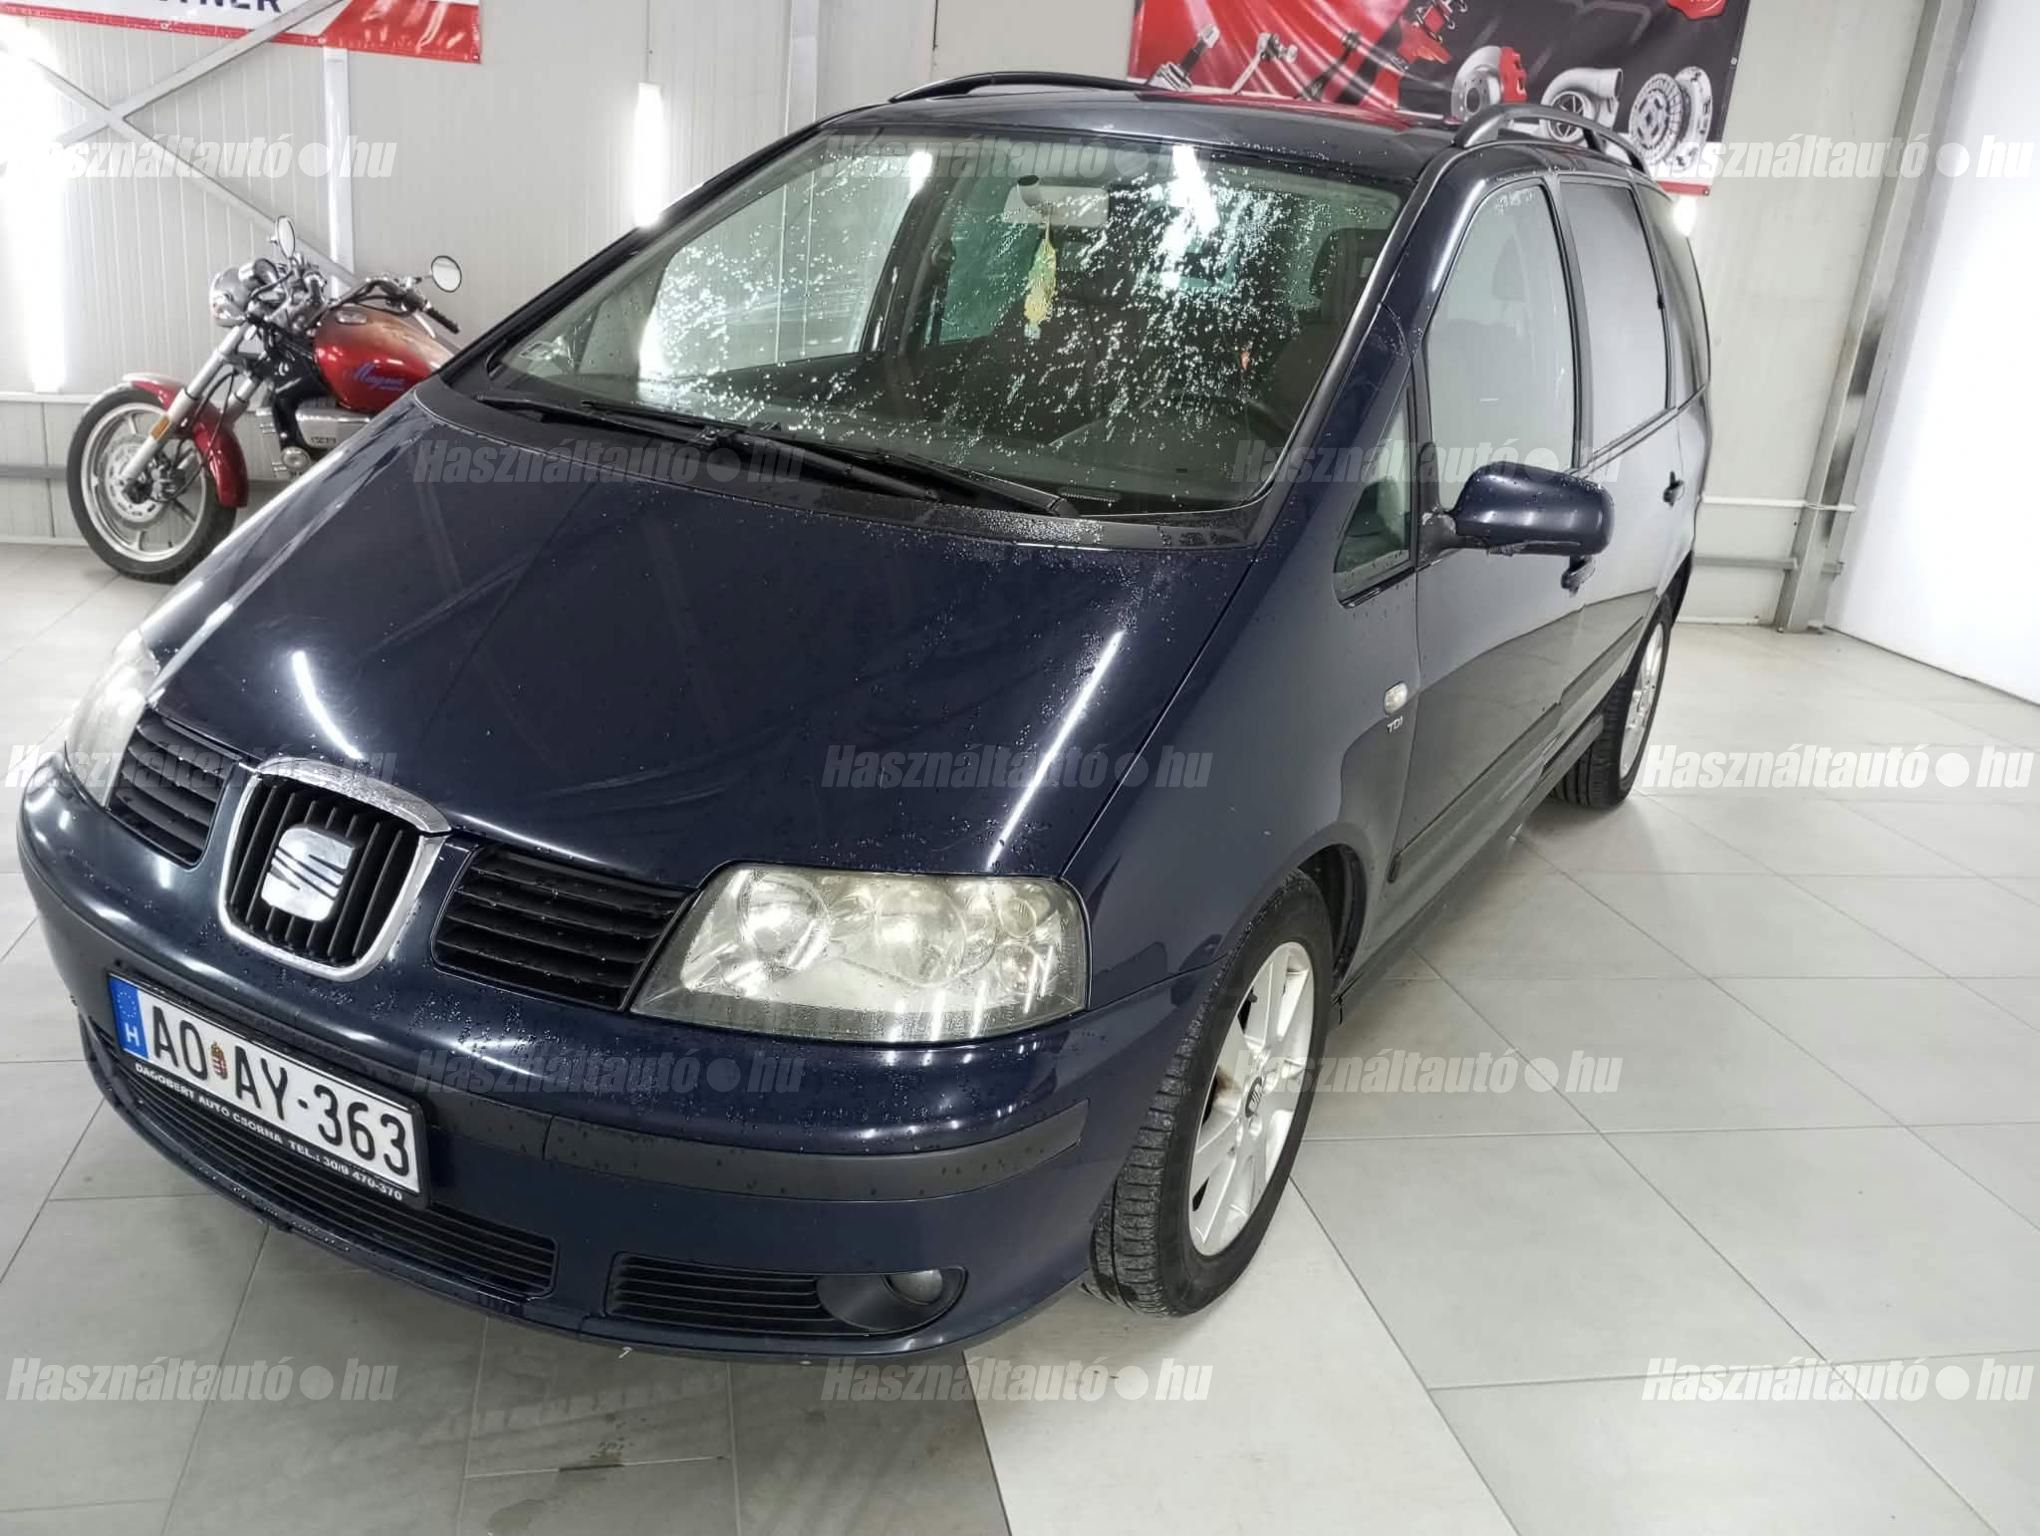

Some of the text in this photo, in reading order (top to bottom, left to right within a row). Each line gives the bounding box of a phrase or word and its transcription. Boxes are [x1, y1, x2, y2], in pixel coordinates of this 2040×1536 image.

[1387, 715, 1403, 733] TDI
[124, 1024, 140, 1048] H
[135, 1062, 195, 1099] DAGOBERT
[199, 1095, 230, 1117] AUTO
[232, 1112, 283, 1144] CSORNA
[352, 1171, 403, 1200] 470-370
